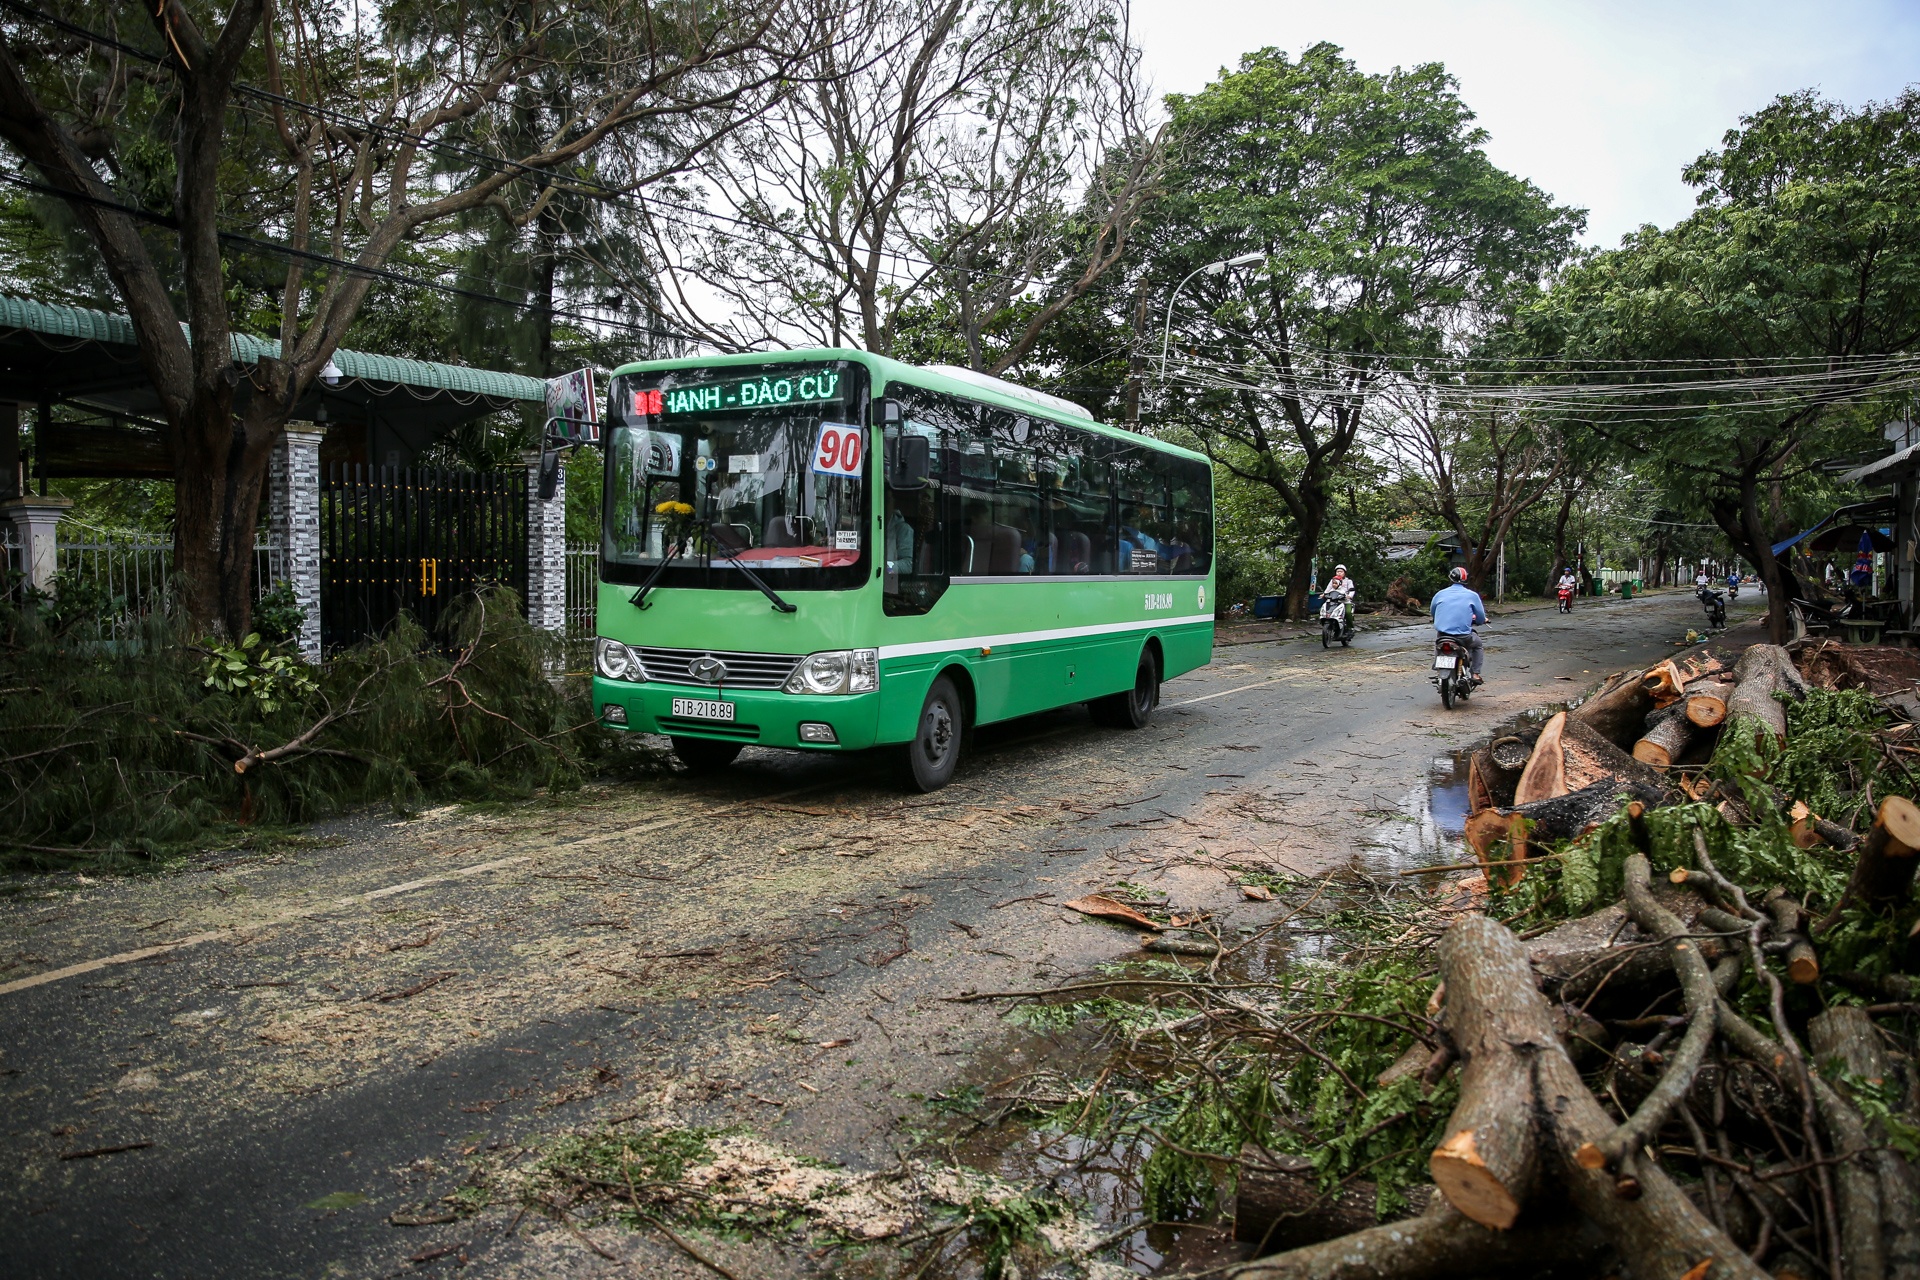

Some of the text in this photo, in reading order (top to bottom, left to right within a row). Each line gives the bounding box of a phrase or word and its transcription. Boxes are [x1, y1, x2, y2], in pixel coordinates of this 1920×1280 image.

[634, 389, 663, 416] 90
[741, 376, 792, 406] ĐÀO
[819, 429, 861, 472] 90
[673, 698, 733, 719] 51B-218.89
